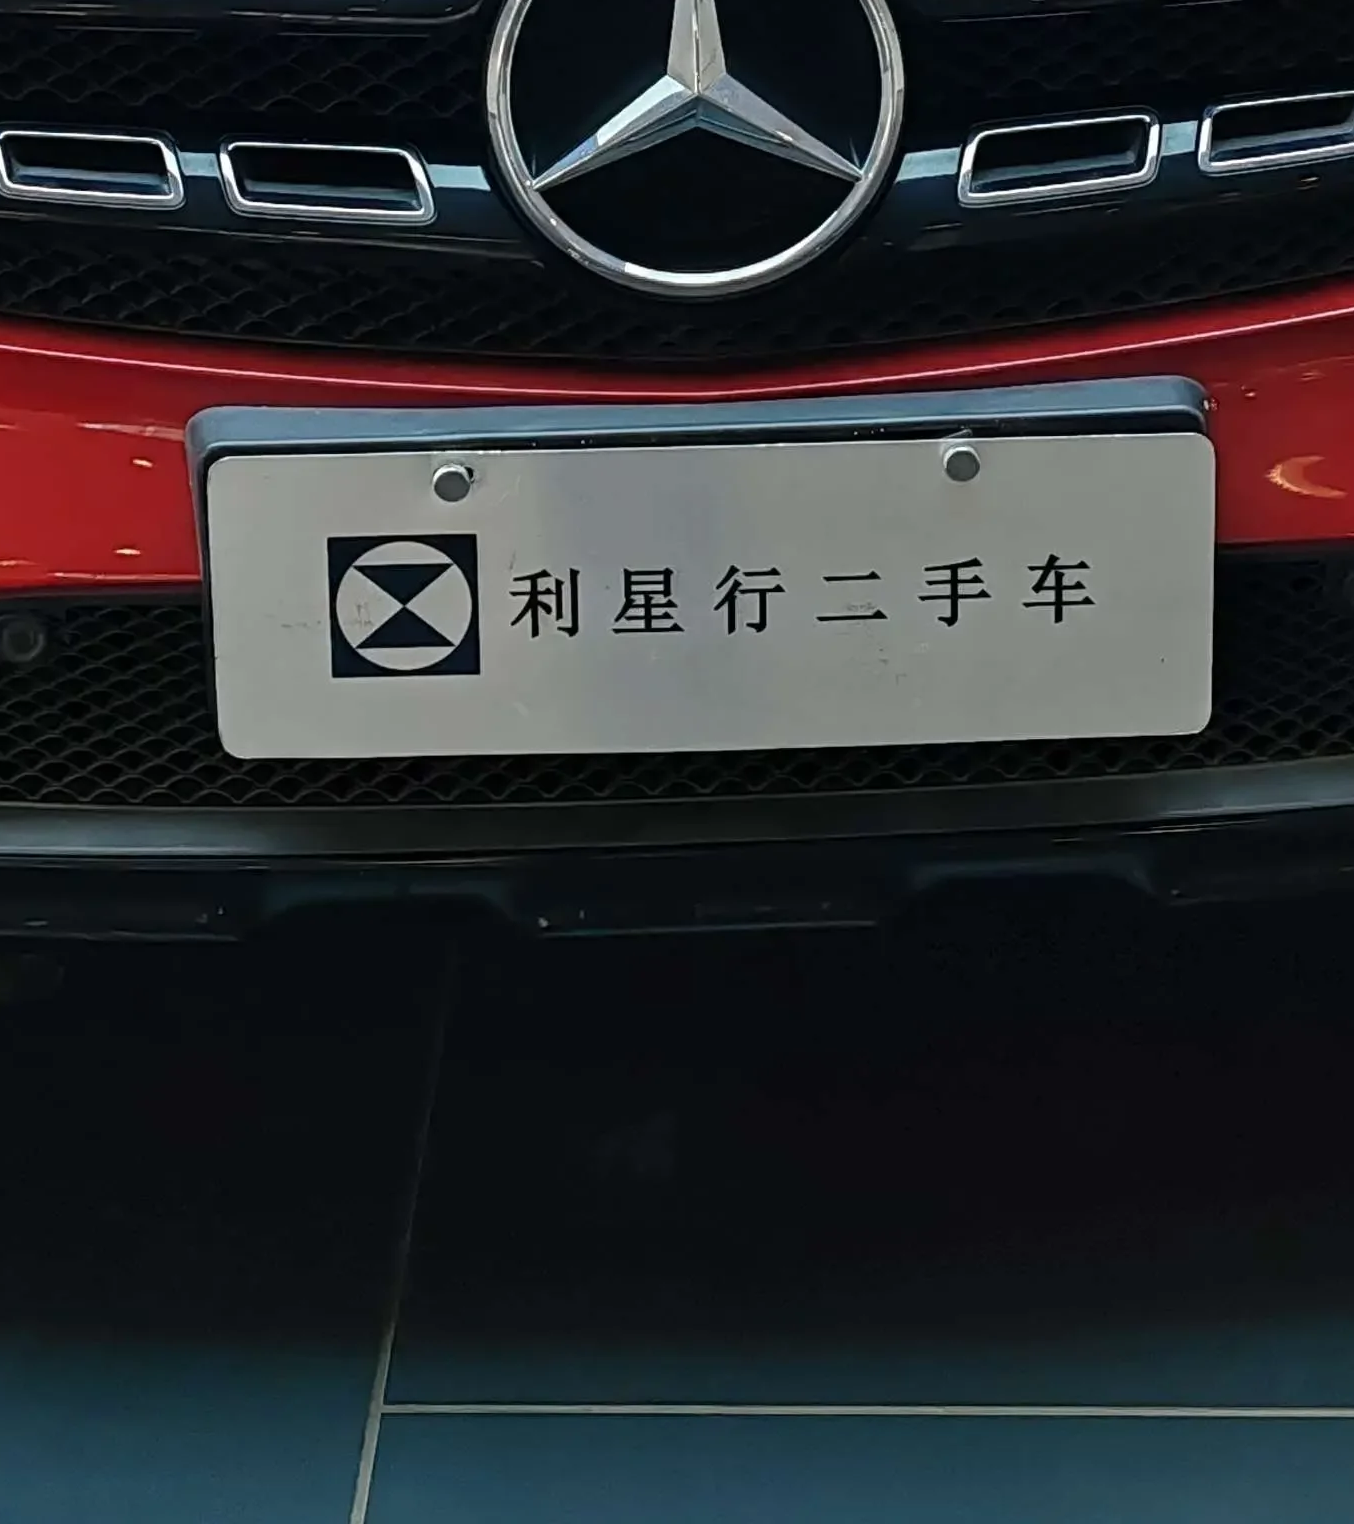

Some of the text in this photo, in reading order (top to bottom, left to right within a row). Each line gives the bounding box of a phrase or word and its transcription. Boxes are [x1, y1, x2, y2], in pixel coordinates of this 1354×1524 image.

[509, 553, 1096, 638] 利星行二手车
